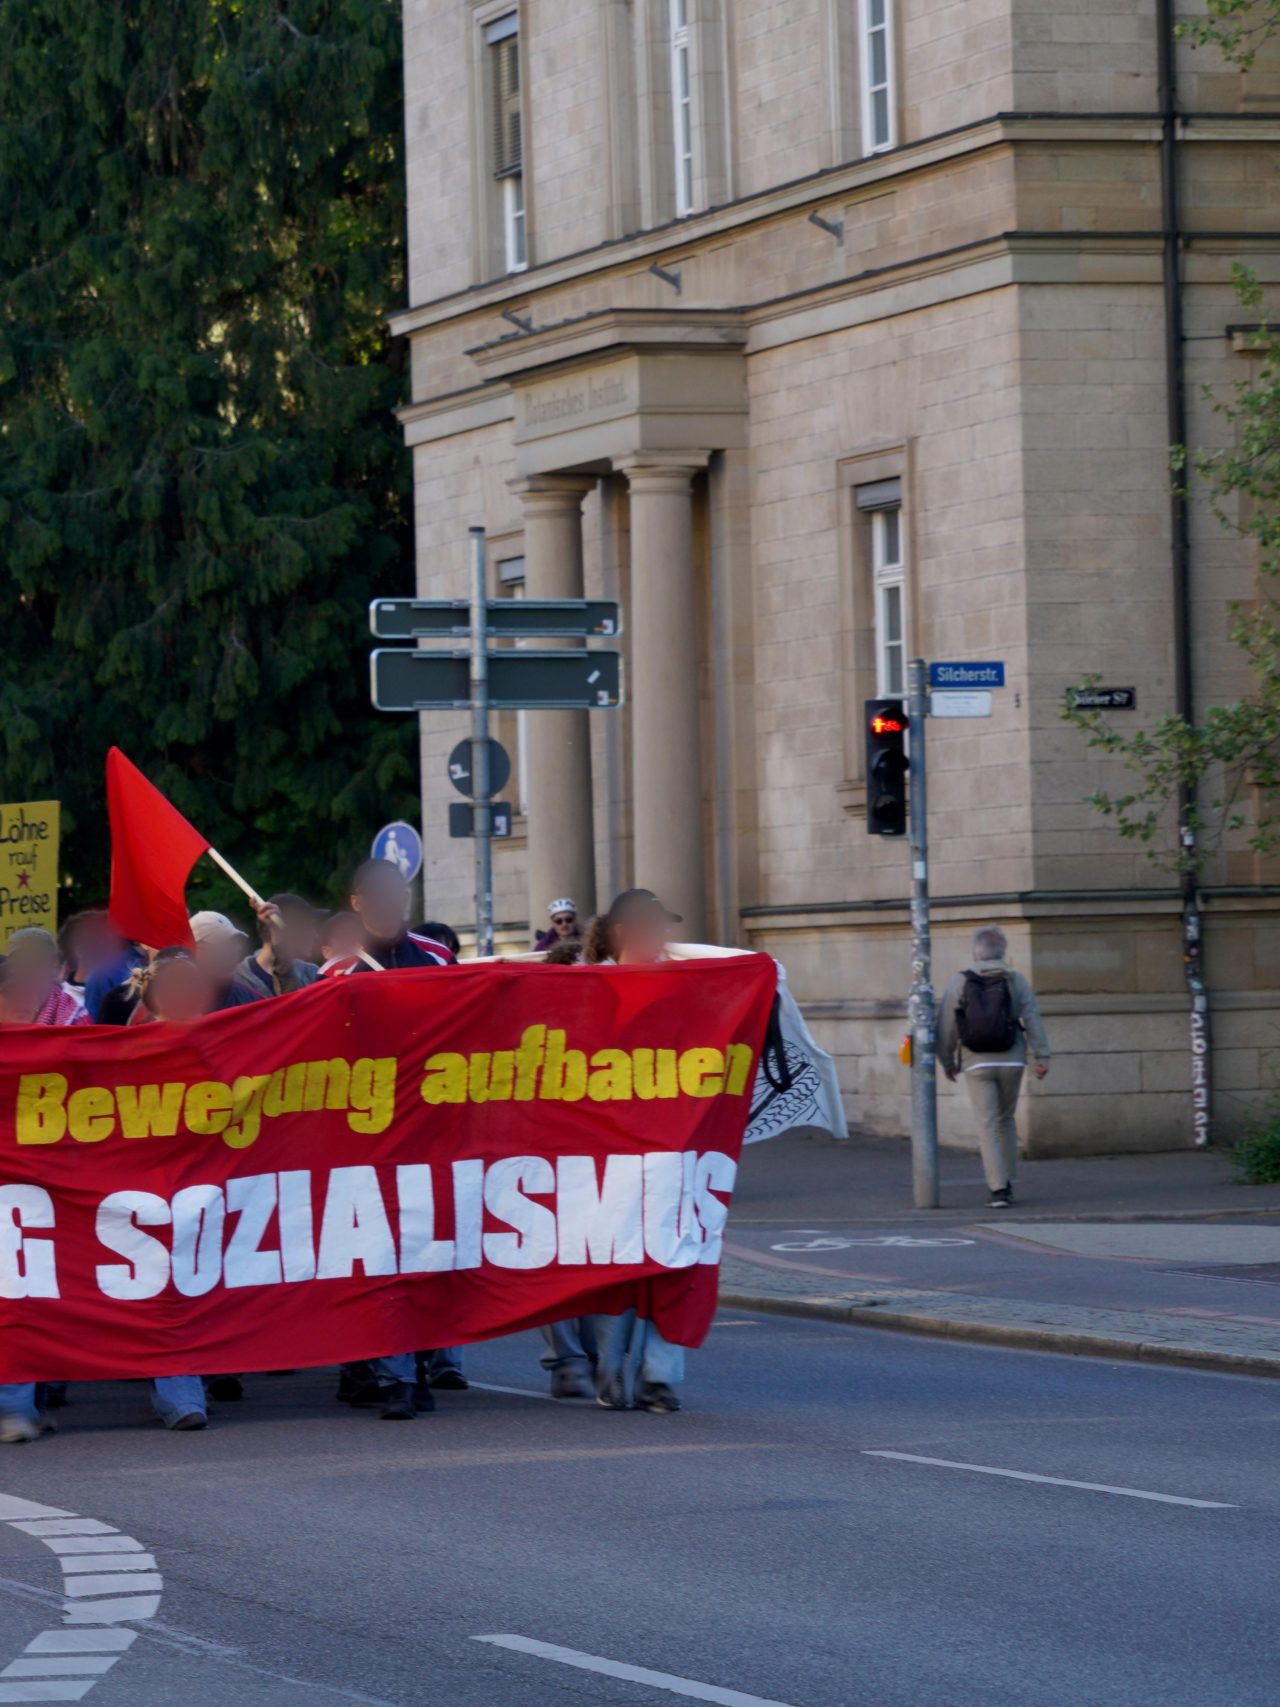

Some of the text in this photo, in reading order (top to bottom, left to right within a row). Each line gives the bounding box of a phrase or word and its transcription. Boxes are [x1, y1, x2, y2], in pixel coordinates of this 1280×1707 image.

[937, 666, 1000, 682] Silcherstr.
[9, 844, 38, 871] rauf
[16, 1056, 397, 1149] Bewegung
[420, 1024, 754, 1105] aufbauen
[95, 1149, 736, 1302] SOZIALISMUS
